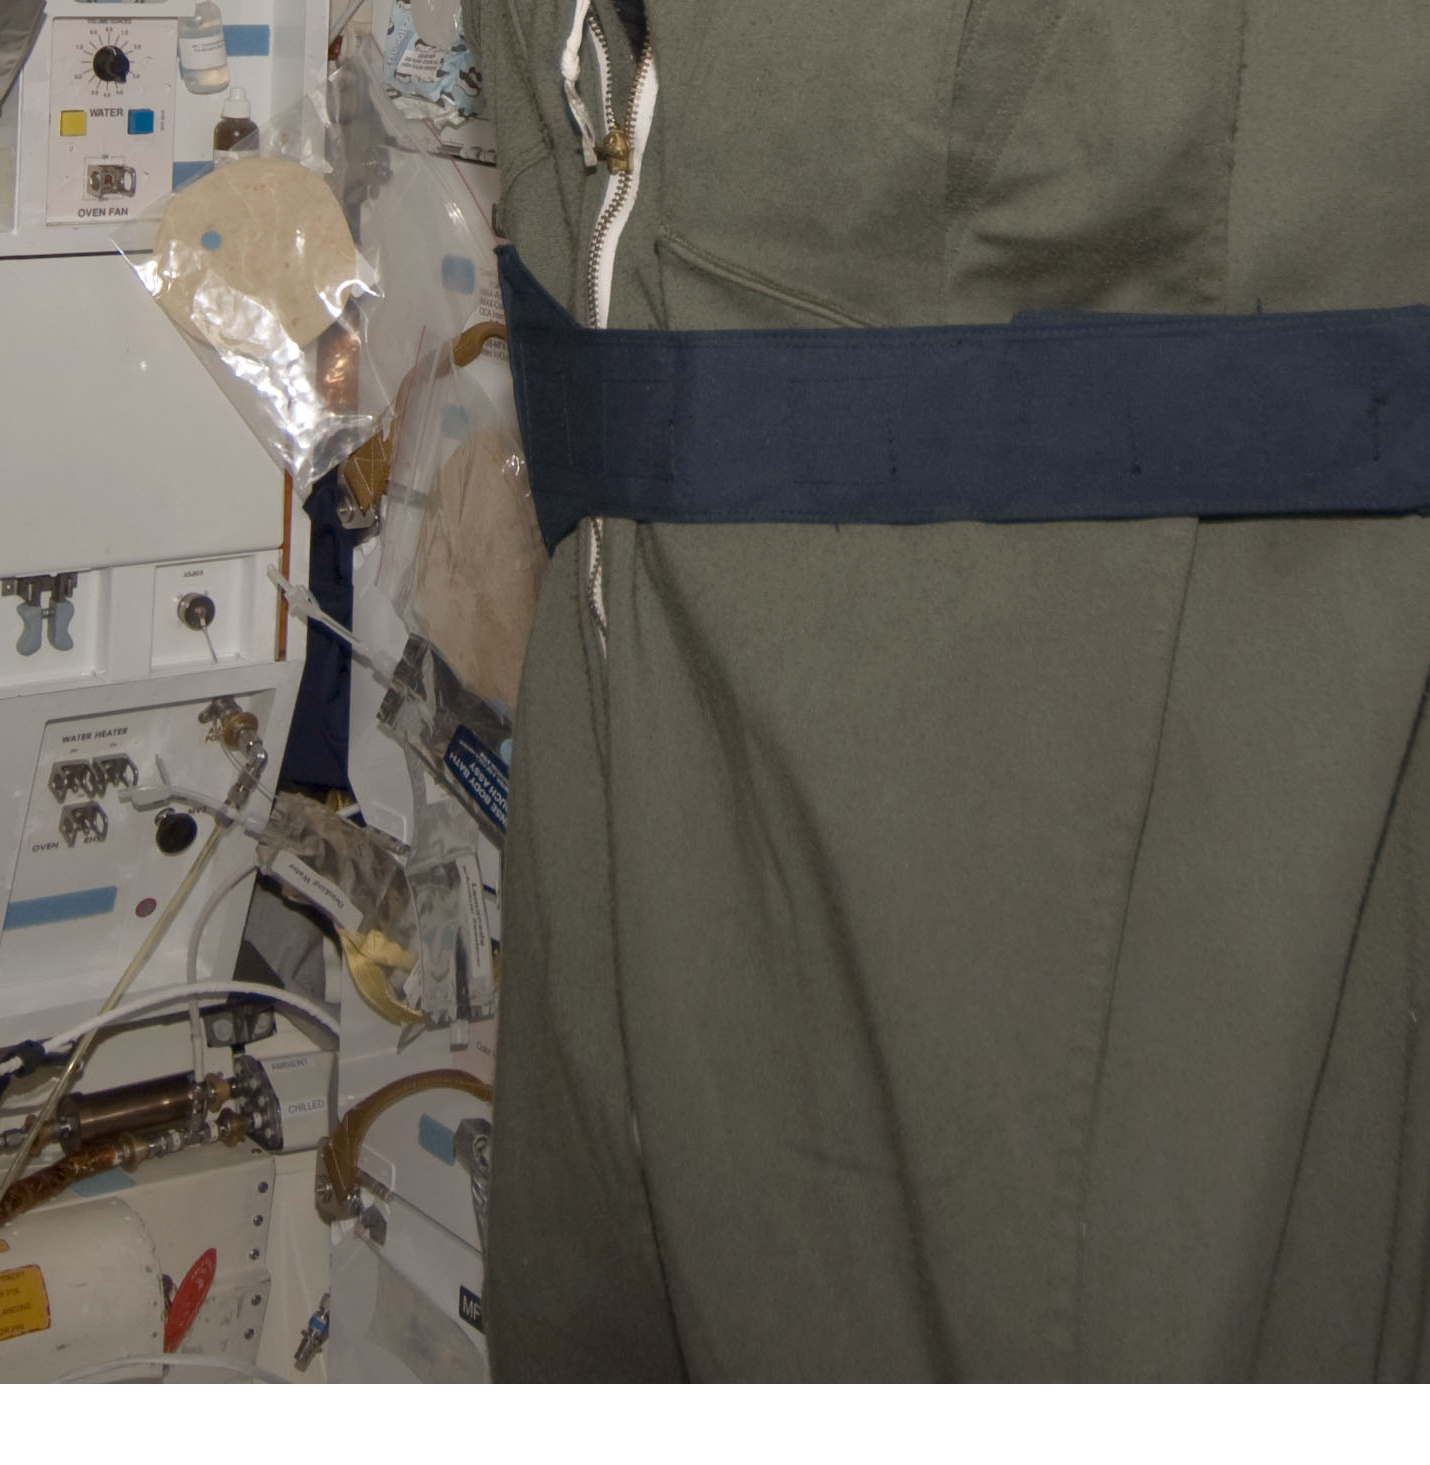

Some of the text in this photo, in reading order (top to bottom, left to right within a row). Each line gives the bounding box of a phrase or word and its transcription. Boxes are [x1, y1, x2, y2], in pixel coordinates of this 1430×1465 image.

[89, 108, 123, 118] WATER
[78, 207, 129, 218] OVEN FAN
[62, 727, 129, 744] WATER HEATER
[32, 841, 59, 853] OVEN
[272, 1058, 308, 1071] AMBIENT
[287, 1099, 325, 1114] CHILLED
[6, 1287, 20, 1297] PIN
[462, 1295, 482, 1321] MF
[10, 1323, 25, 1333] PIN
